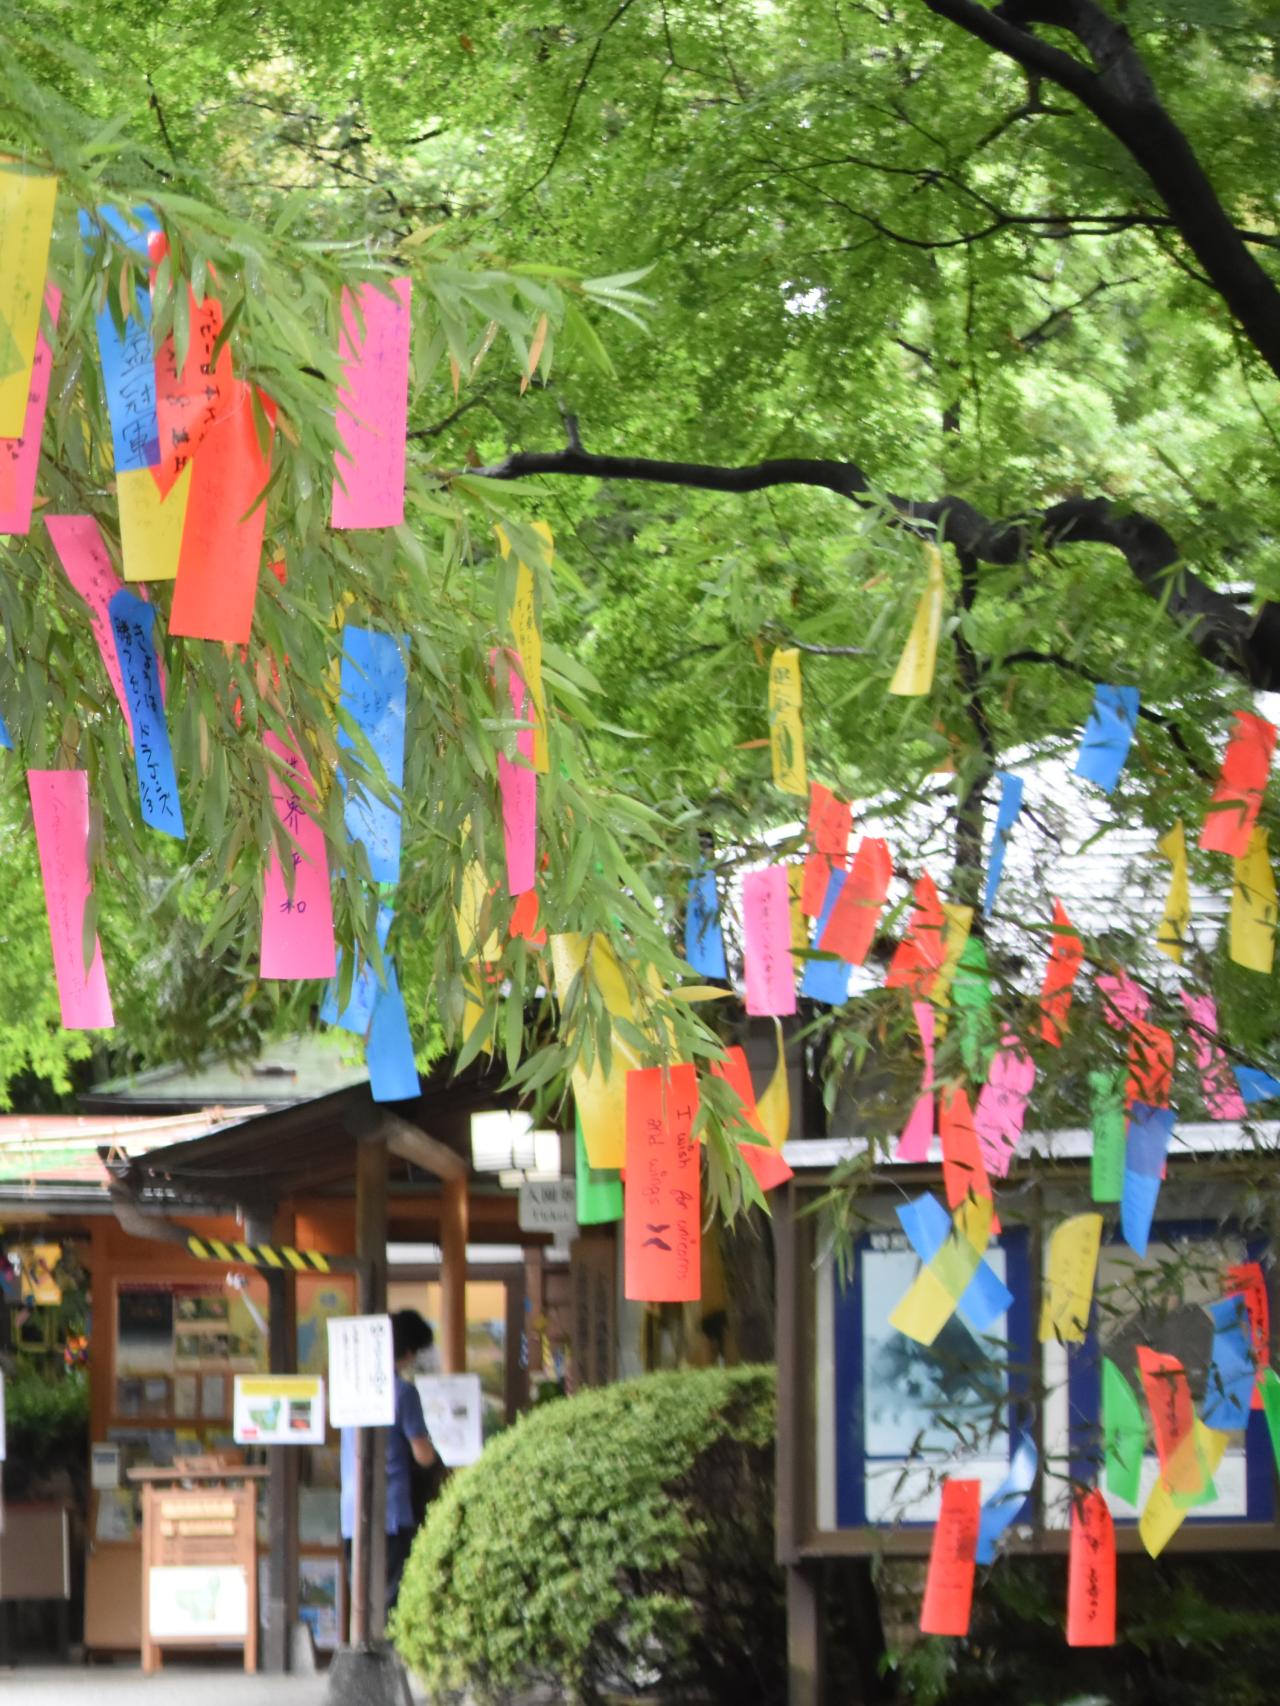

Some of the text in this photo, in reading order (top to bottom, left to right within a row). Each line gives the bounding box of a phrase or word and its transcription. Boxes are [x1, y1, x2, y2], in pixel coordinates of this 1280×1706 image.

[676, 1105, 691, 1120] I
[642, 1118, 668, 1207] and wings
[676, 1132, 694, 1169] wish
[669, 1187, 694, 1209] for
